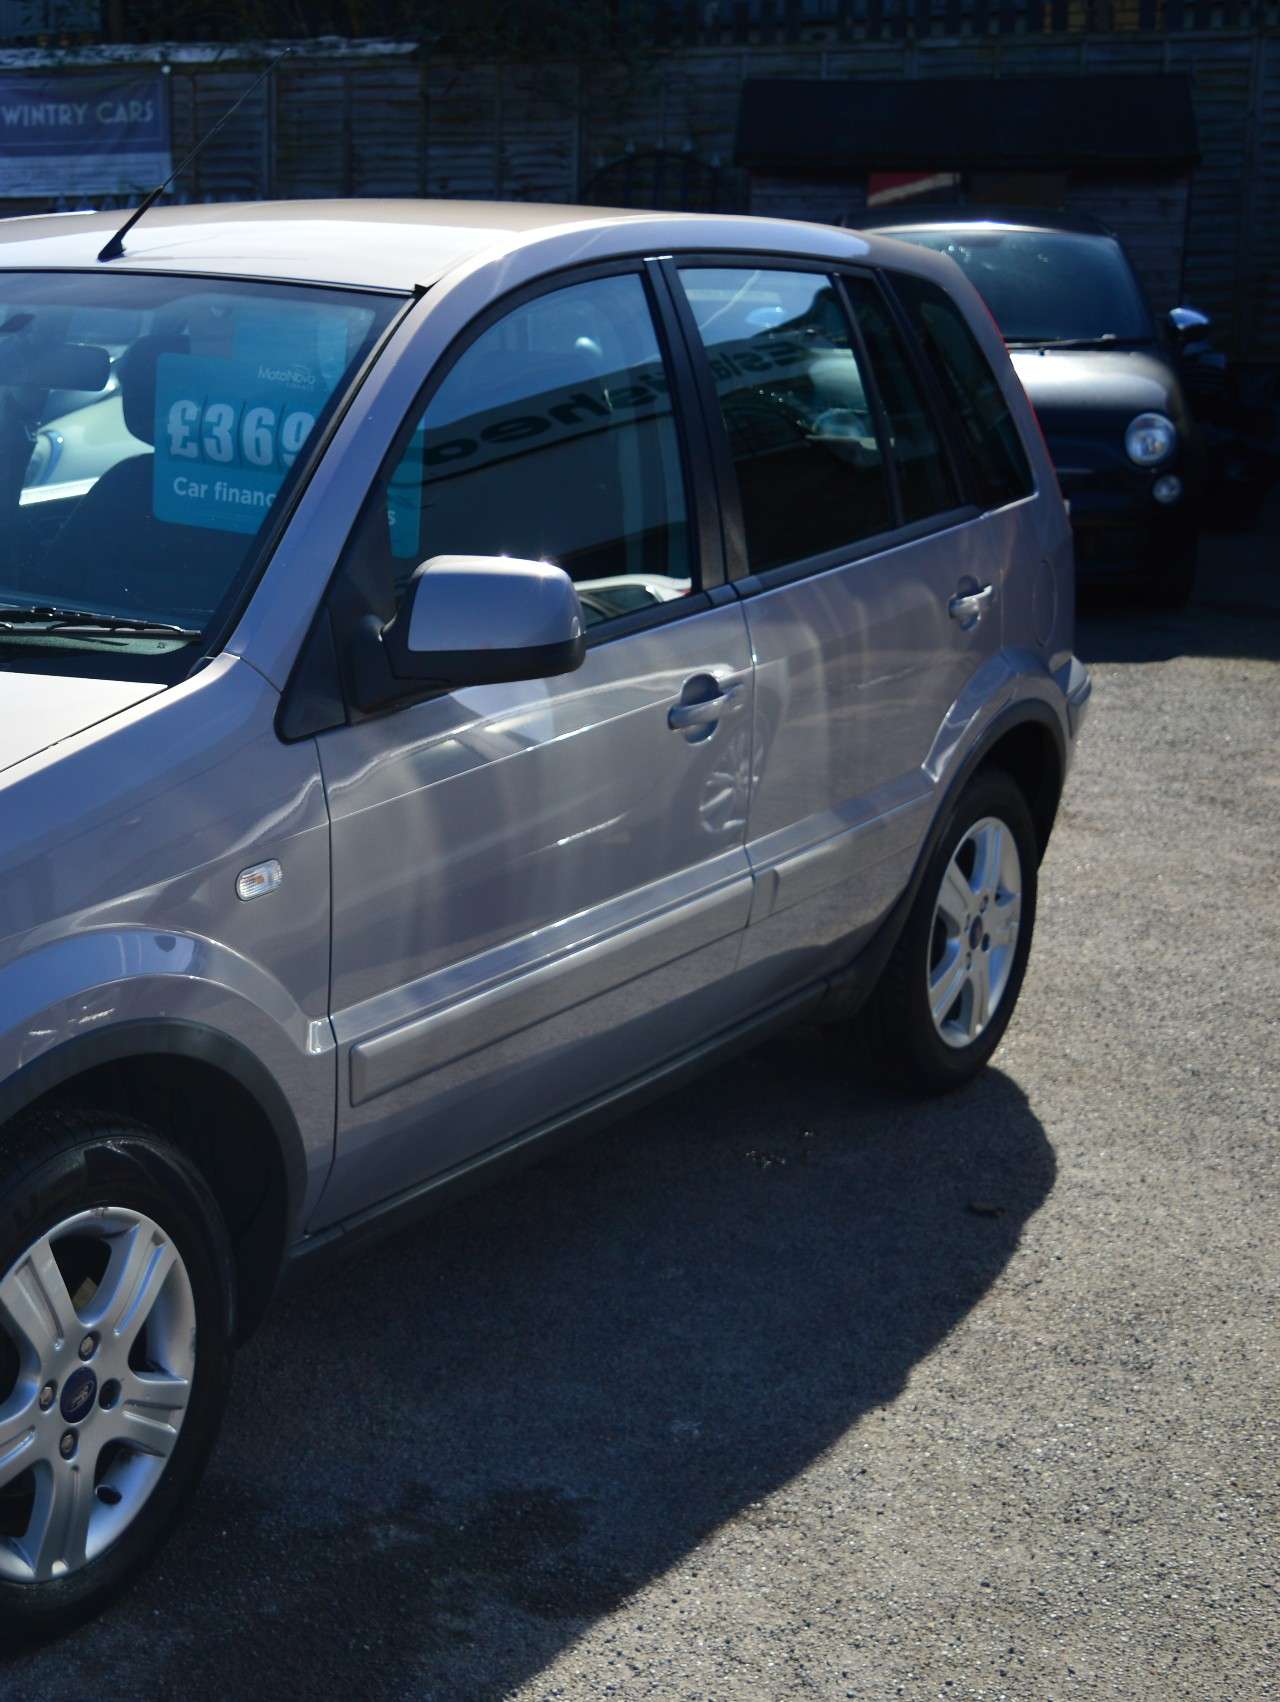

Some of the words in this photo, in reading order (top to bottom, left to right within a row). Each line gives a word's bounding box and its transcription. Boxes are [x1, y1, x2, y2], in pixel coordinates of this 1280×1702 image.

[1, 103, 89, 127] WINTRY
[96, 100, 154, 124] CARS
[173, 476, 209, 499] Car
